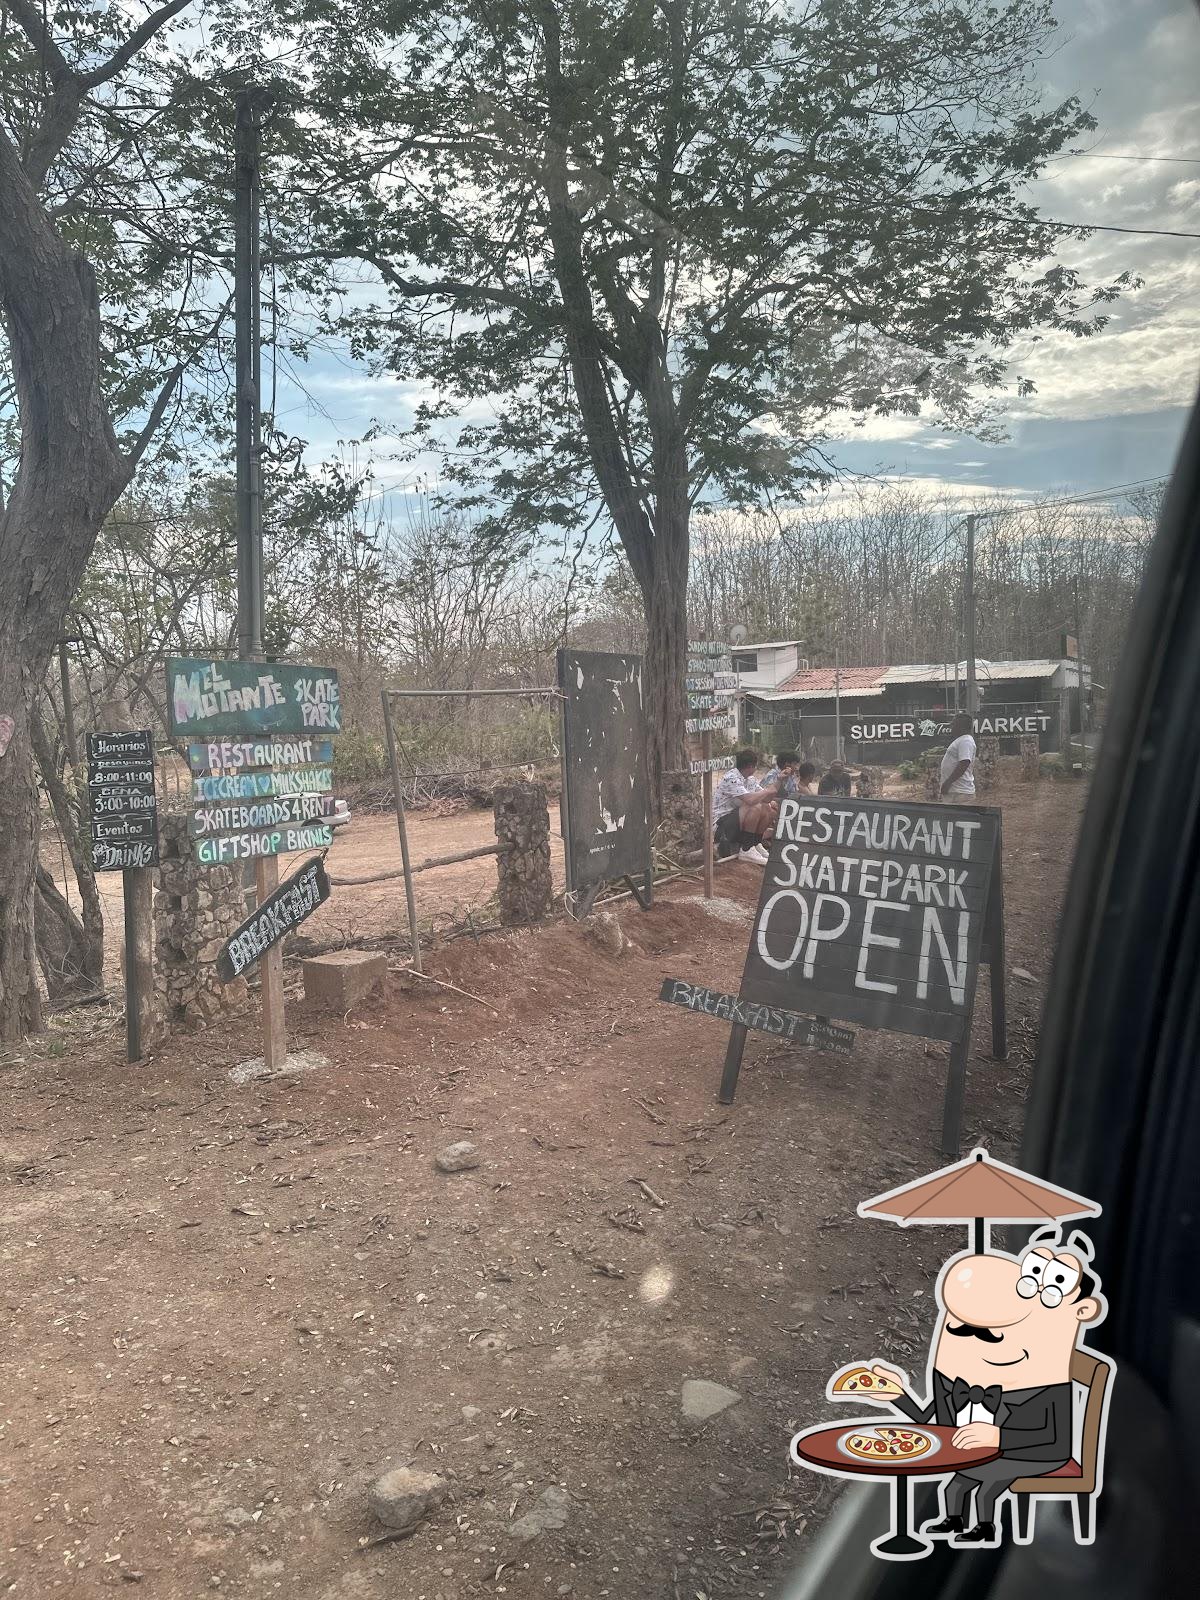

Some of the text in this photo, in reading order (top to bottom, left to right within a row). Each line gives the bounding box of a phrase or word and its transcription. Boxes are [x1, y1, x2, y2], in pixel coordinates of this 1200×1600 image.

[294, 678, 340, 704] SKATE
[691, 695, 712, 710] SKATE
[301, 702, 341, 730] PARK
[686, 715, 732, 734] ART WORKSHOPS
[850, 722, 916, 740] SUPER
[97, 740, 146, 753] Horarios
[207, 740, 313, 769] RESTAURANT
[96, 821, 143, 837] Eventos
[194, 796, 334, 834] SKATEBOARDS 4 RENT
[287, 825, 333, 851] BIKINIS
[775, 799, 981, 860] RESTAURANT
[773, 844, 969, 909] SKATEPARK
[228, 865, 321, 976] BREAKFAST
[757, 889, 971, 1005] OPEN
[671, 980, 801, 1037] BREAKFAST
